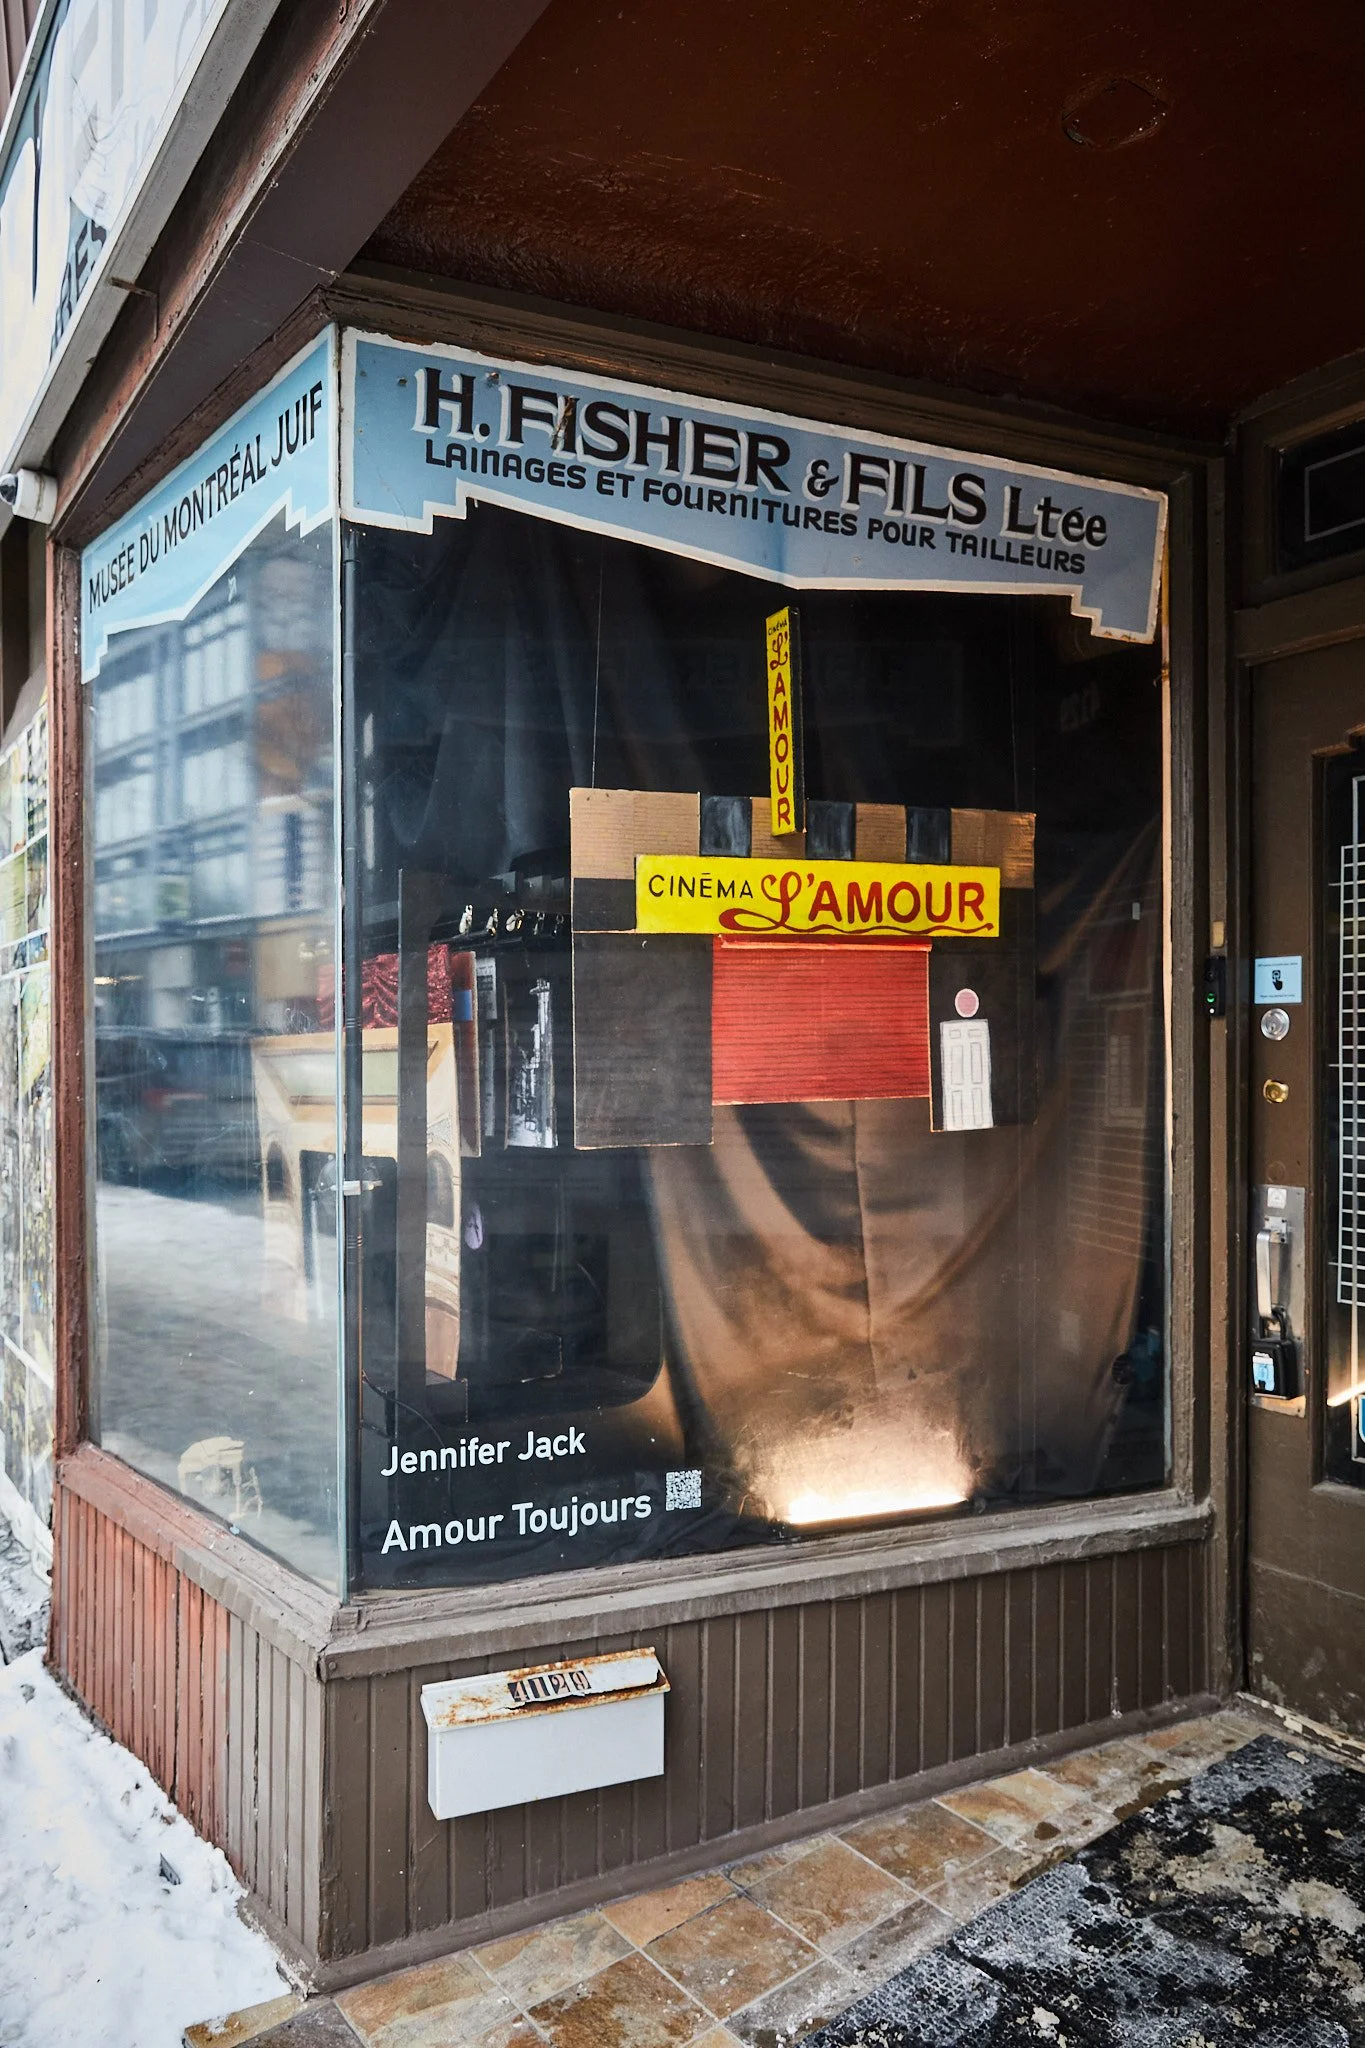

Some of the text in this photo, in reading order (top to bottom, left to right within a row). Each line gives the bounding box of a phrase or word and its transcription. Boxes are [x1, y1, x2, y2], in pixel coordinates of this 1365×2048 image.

[417, 366, 1108, 548] H. FISHER & FILS Ltée
[89, 380, 323, 614] MUSÉE DU MONTRÉAL JUIF
[425, 438, 1085, 575] LAINAGES ET FOURNITURES POUR TAILLEURS
[719, 871, 994, 934] L'AMOUR
[380, 1426, 586, 1477] Jennifer Jack
[381, 1494, 652, 1555] Amour Toujours
[509, 1670, 591, 1702] 4129
